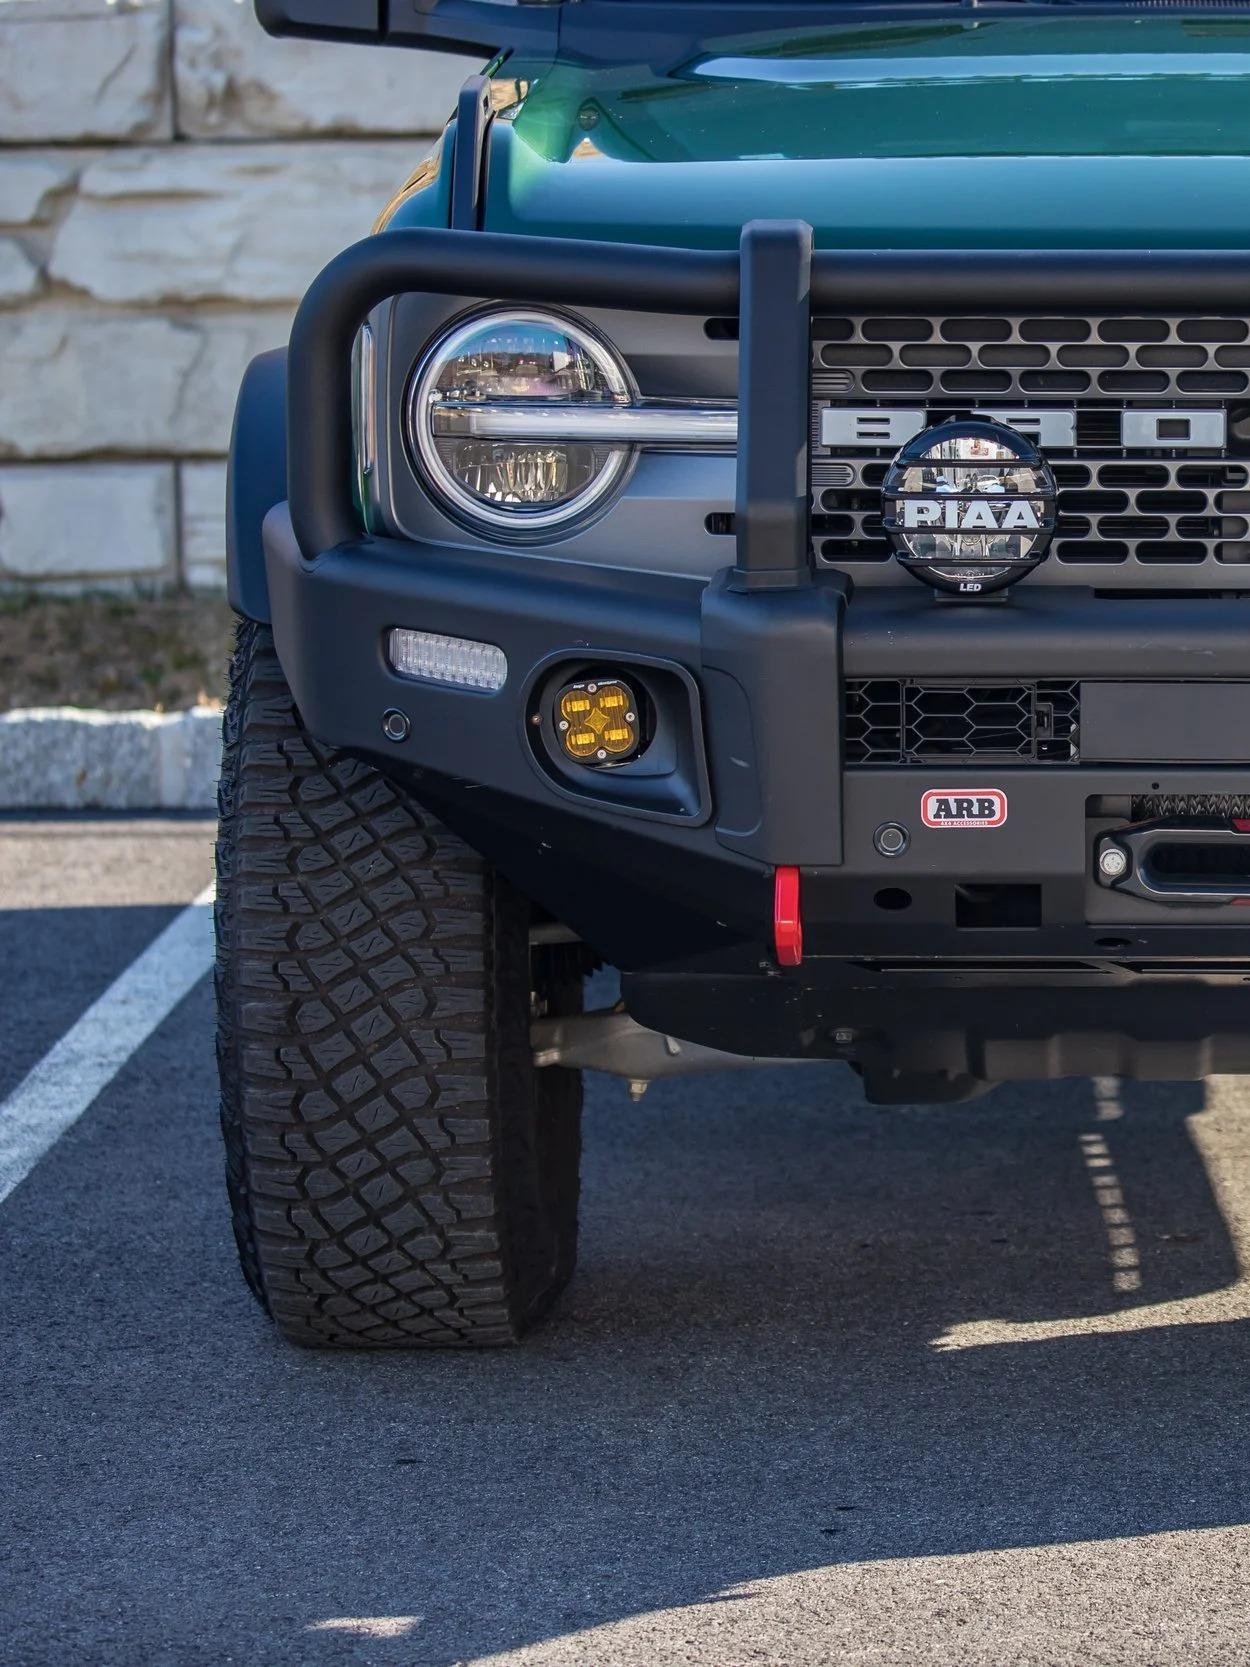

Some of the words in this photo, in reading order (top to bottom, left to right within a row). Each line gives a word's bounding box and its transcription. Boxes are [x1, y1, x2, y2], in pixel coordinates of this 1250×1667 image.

[904, 500, 1040, 529] PIAA
[960, 583, 982, 592] LED
[933, 798, 996, 819] ARB
